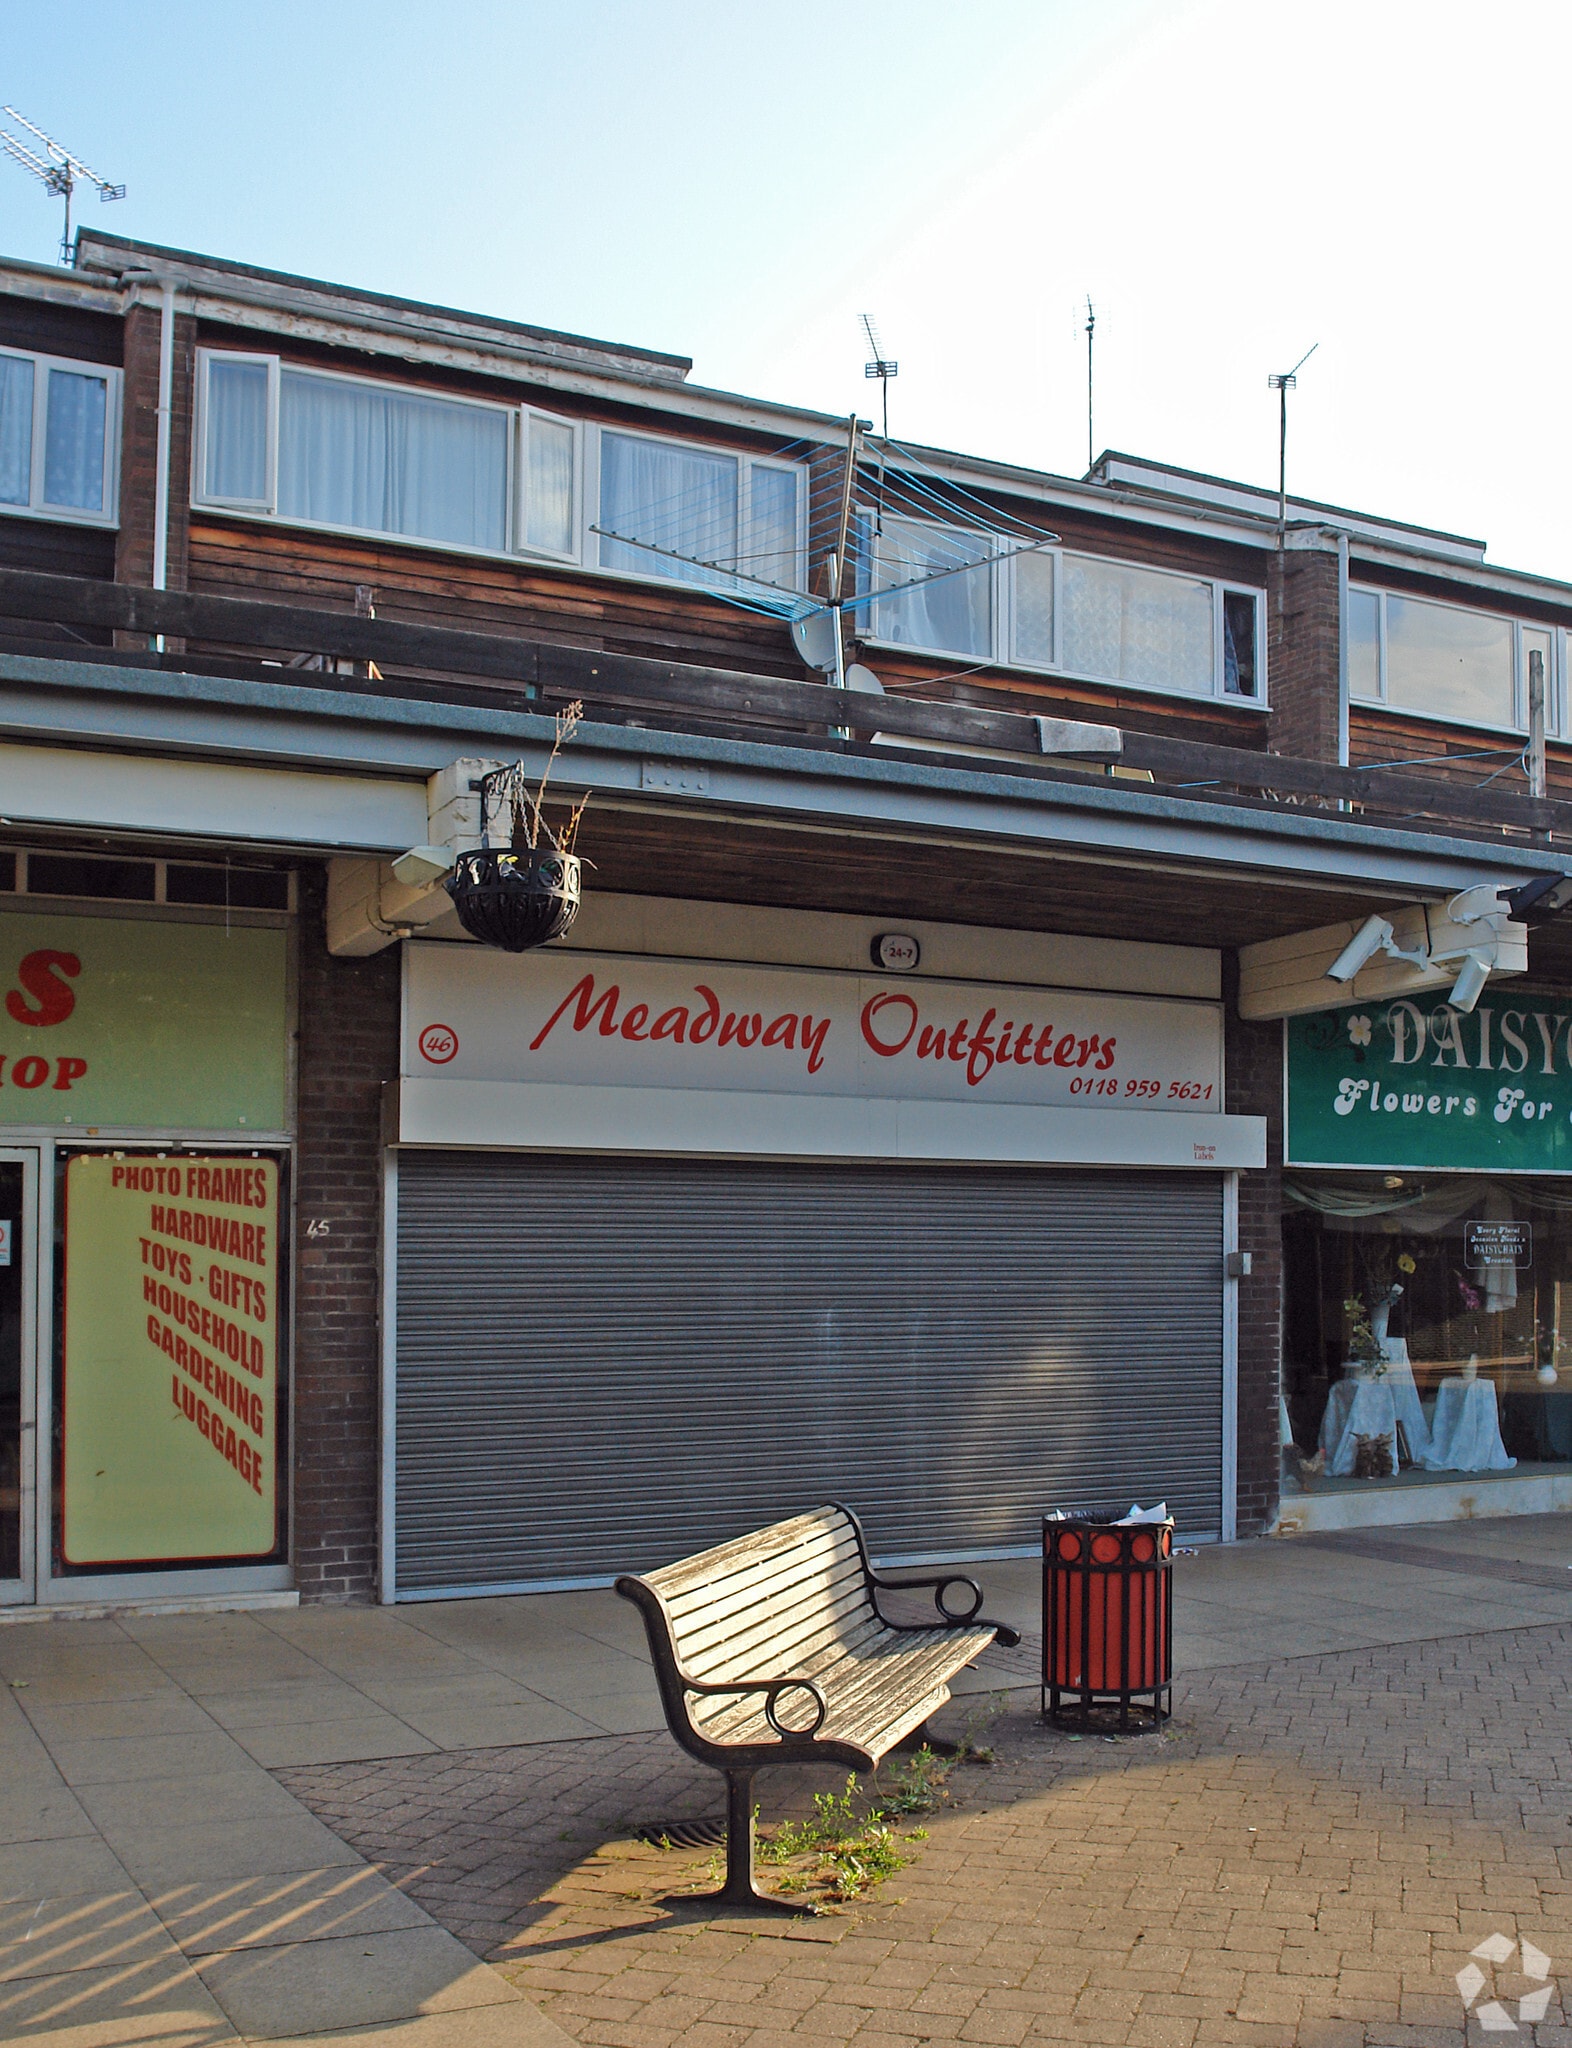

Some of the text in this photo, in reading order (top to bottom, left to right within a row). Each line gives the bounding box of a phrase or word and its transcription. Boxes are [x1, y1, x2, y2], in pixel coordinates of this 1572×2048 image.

[889, 947, 913, 958] 24-7
[5, 948, 82, 1027] S
[426, 1036, 451, 1052] 46
[529, 973, 1116, 1086] Meadway Outfitters
[1386, 1000, 1572, 1075] DAISY
[0, 1055, 87, 1090] OP
[1069, 1077, 1213, 1100] 0118 959 5621
[1333, 1077, 1477, 1116] Flowers
[1493, 1087, 1553, 1123] For
[112, 1166, 266, 1209] PHOTO FRAMES
[151, 1203, 266, 1266] HARDWARE
[306, 1218, 331, 1240] 45
[1473, 1244, 1523, 1255] DAISYCHAIN
[139, 1236, 266, 1323] TOYS GIFTS
[143, 1275, 264, 1379] HOUSEHOLD
[147, 1314, 264, 1438] GARDENING
[172, 1374, 263, 1497] LUGGAGE
